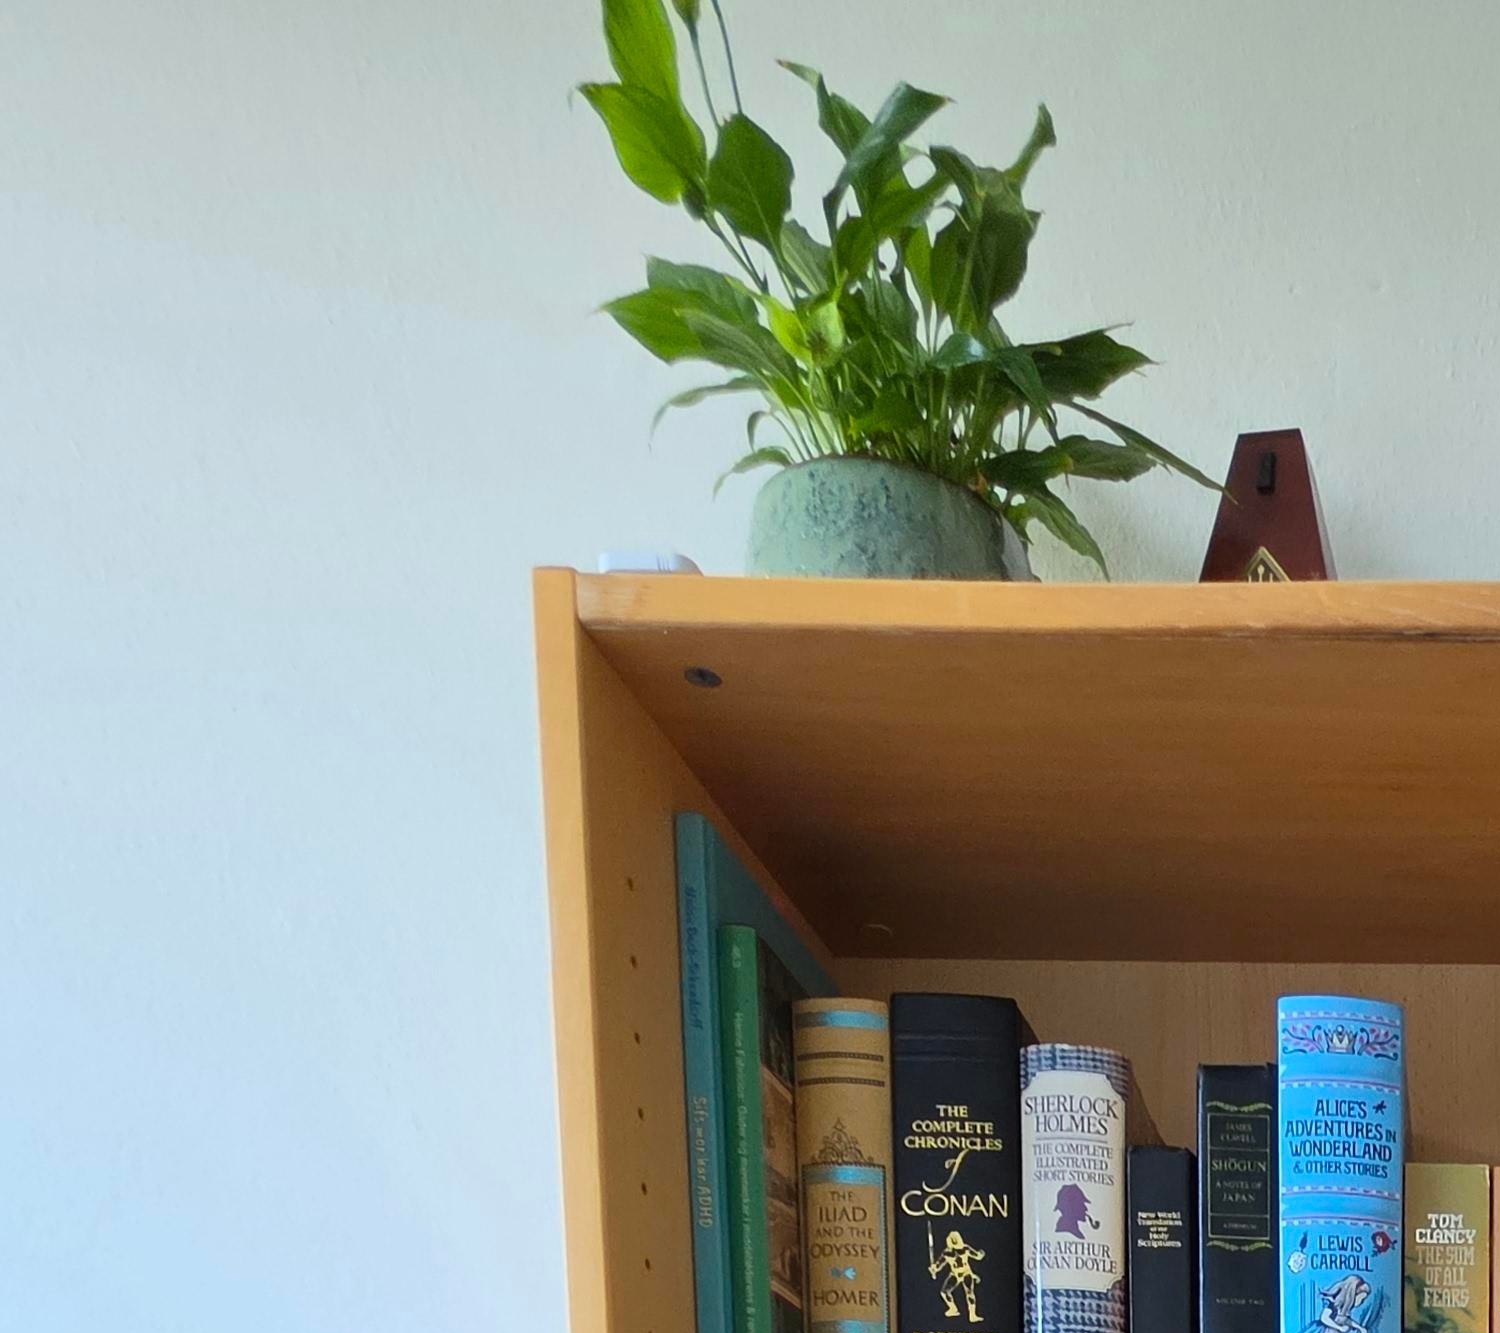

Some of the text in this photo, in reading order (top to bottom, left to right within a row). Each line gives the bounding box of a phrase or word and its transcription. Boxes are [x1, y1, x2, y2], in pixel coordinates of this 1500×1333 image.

[936, 1104, 969, 1118] THE
[1024, 1095, 1118, 1120] SHERLOCK
[1315, 1099, 1368, 1120] ALICE'S
[912, 1120, 994, 1135] COMPLETE
[1035, 1114, 1108, 1136] HOLMES
[1285, 1120, 1397, 1143] ADVENTURES IN
[905, 1136, 1003, 1150] CHRONICLES
[1289, 1140, 1393, 1163] WONDERLAND
[1032, 1144, 1114, 1160] THE COMPLETE
[1036, 1156, 1109, 1172] ILLUSTRATED
[1305, 1162, 1342, 1174] OTHER
[1344, 1162, 1389, 1179] STORIES
[1033, 1171, 1115, 1186] SHORT STORIES
[830, 1190, 856, 1201] THE
[901, 1190, 1008, 1218] CONAN
[819, 1206, 868, 1224] ILIAD
[1428, 1214, 1464, 1229] TOM
[816, 1227, 874, 1239] AND THE
[1415, 1229, 1477, 1245] CLANCY
[811, 1244, 880, 1259] ODYSSEY
[1033, 1242, 1111, 1259] SIR ARTHUR
[1318, 1235, 1363, 1252] LEWIS
[1310, 1253, 1374, 1272] CARROLL
[1417, 1246, 1475, 1266] THE SUM
[1075, 1256, 1118, 1274] DOYLE
[1426, 1266, 1468, 1287] OF ALL
[813, 1289, 880, 1307] HOMER
[1423, 1287, 1471, 1308] FEARS
